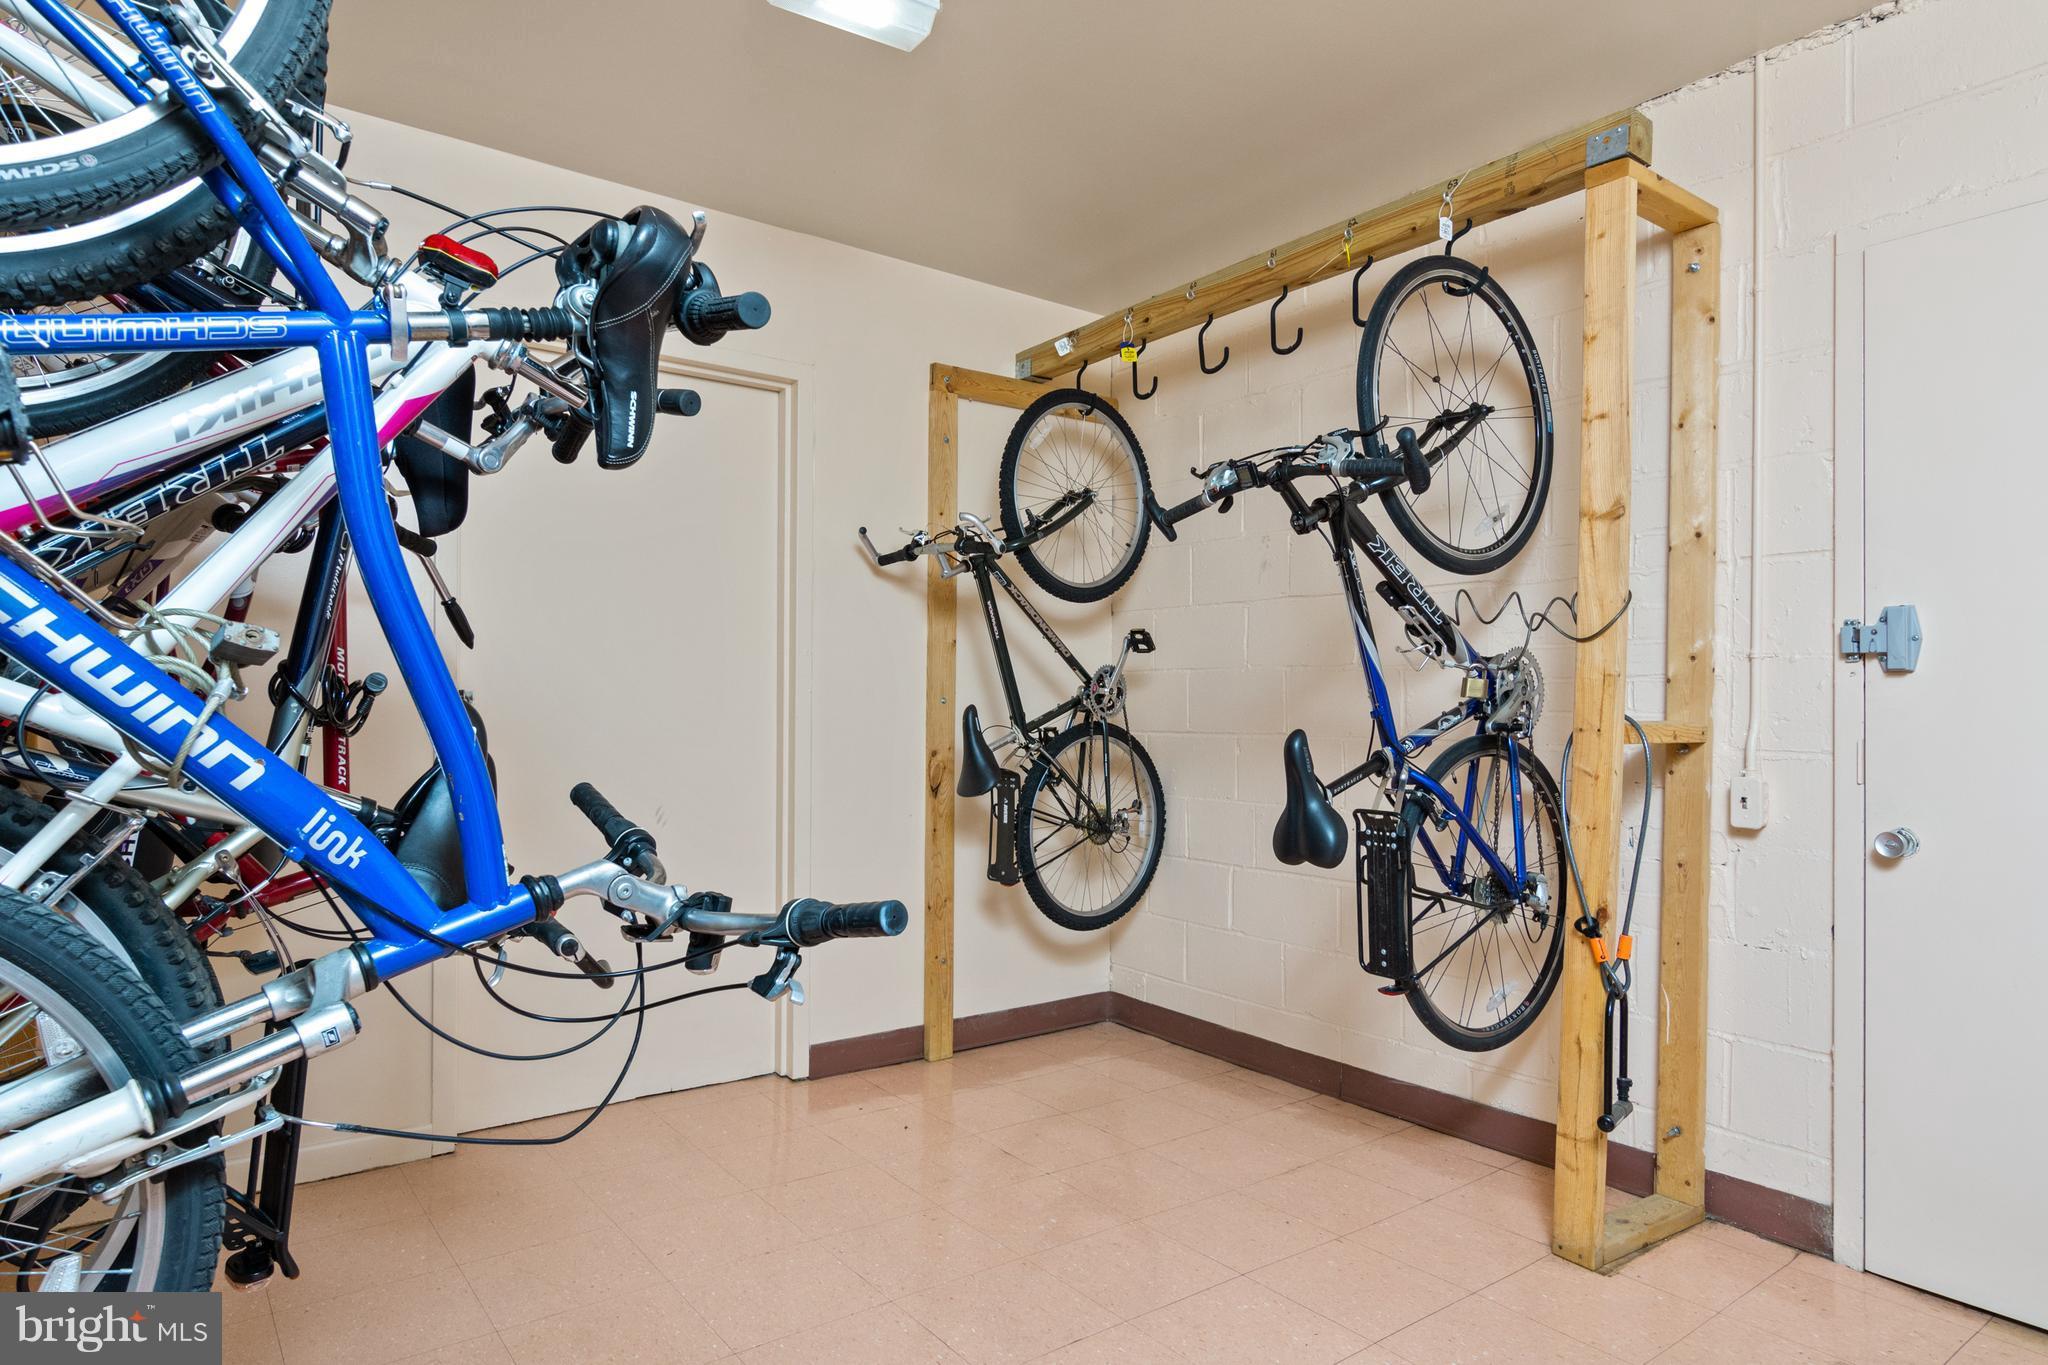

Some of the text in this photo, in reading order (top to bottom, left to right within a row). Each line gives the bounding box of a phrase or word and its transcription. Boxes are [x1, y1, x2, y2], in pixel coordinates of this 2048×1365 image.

[1447, 178, 1459, 190] 63
[2, 316, 288, 344] SCHWINN
[626, 390, 638, 449] SCHWINN
[37, 433, 285, 568] TREK
[1366, 534, 1443, 625] TREK
[337, 737, 347, 786] TRACK
[1333, 773, 1363, 794] BONTRAGER
[302, 807, 368, 869] link
